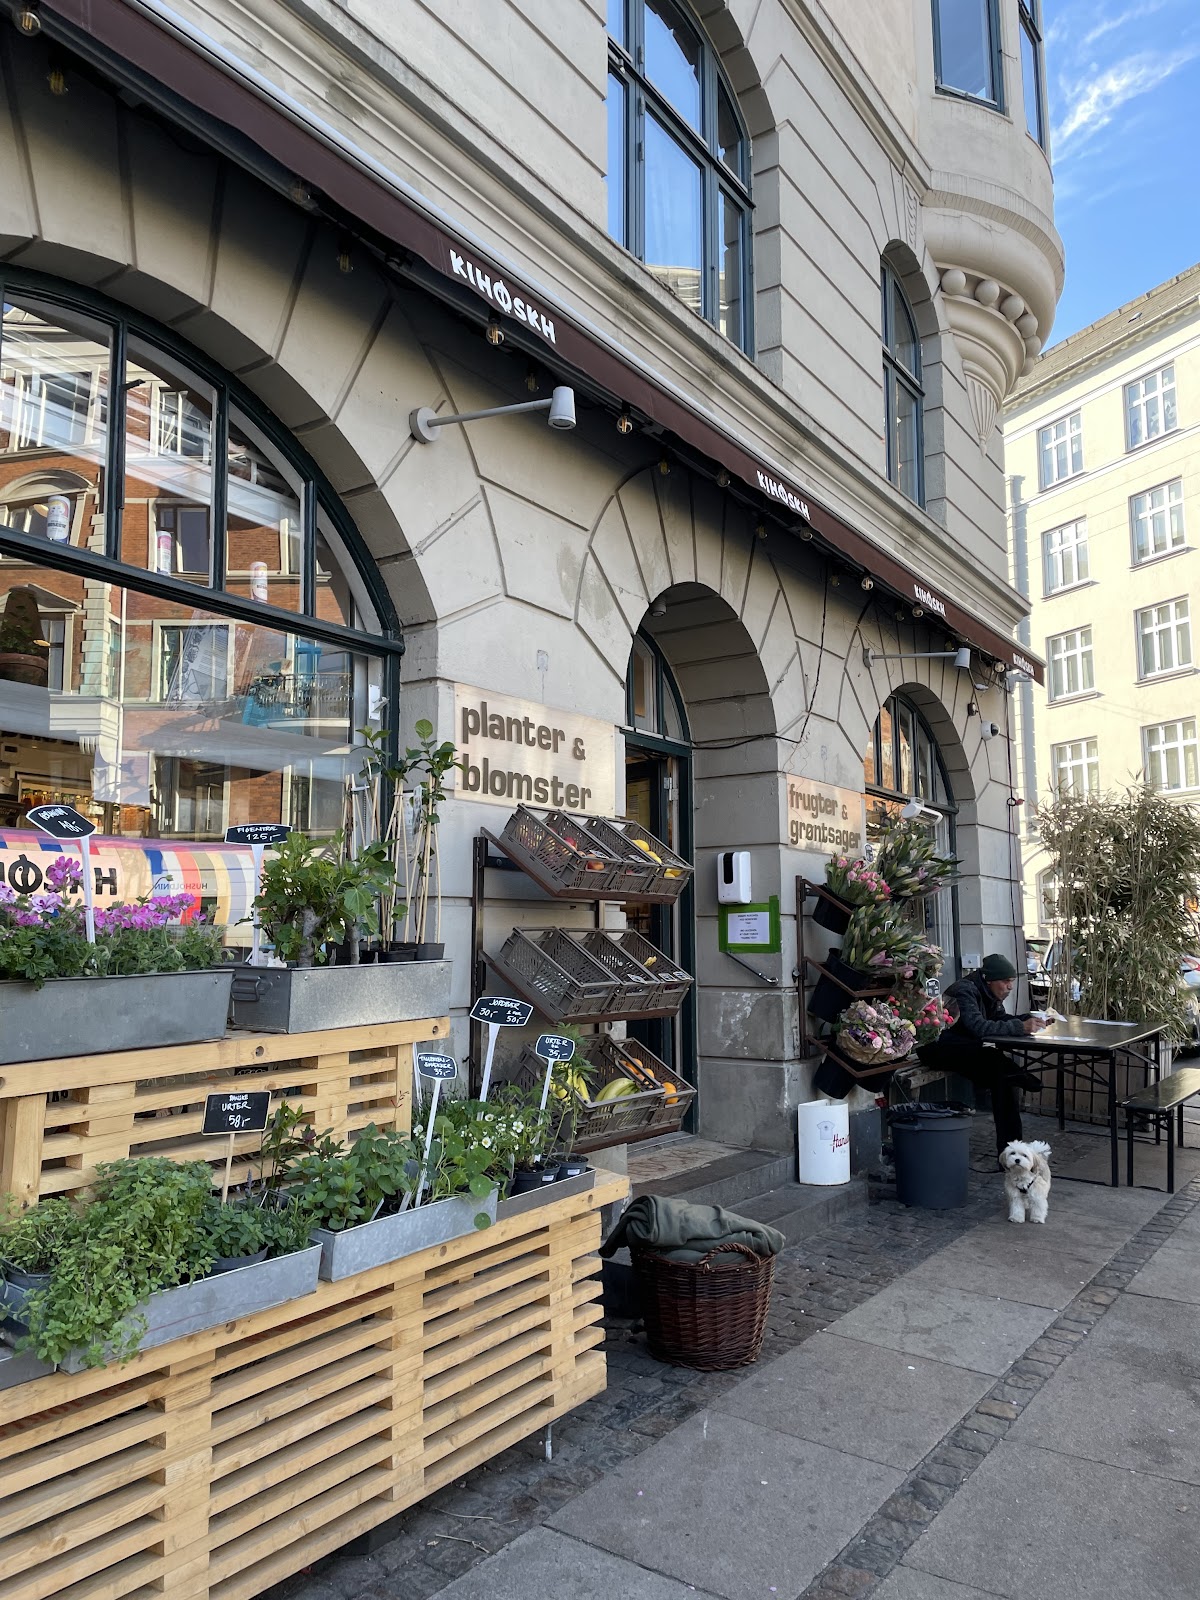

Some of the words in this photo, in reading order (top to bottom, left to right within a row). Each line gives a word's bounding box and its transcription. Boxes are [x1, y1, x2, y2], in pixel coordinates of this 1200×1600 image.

[449, 249, 556, 344] KIHØSKH
[462, 701, 566, 753] planter
[573, 737, 586, 761] &
[462, 753, 592, 810] blomster
[789, 783, 838, 819] frugter
[841, 804, 849, 820] &
[790, 819, 861, 853] grøntsager
[221, 1101, 251, 1111] URTER
[228, 1114, 251, 1128] 58,-
